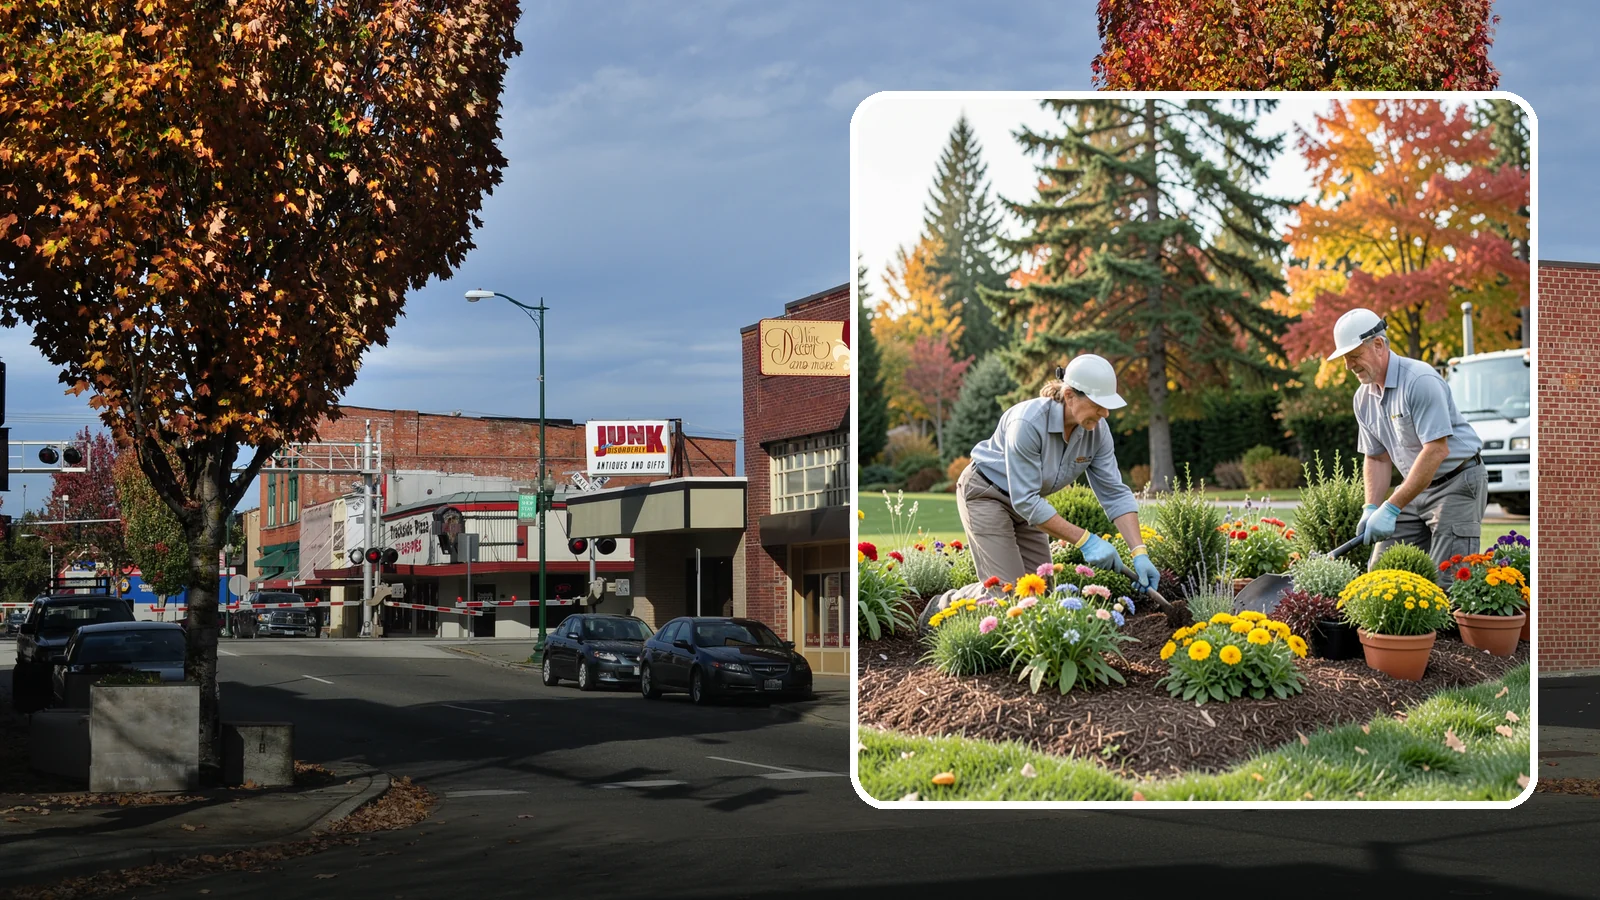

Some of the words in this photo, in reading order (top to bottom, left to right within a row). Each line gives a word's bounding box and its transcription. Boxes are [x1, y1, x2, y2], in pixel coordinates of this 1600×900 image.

[595, 425, 665, 457] JUNK
[607, 446, 645, 454] DISORDERLY
[597, 461, 628, 470] ANTIQUES
[631, 461, 644, 469] AND
[647, 460, 665, 469] GIFTS
[573, 473, 587, 491] RAIL
[415, 519, 429, 534] Pizza
